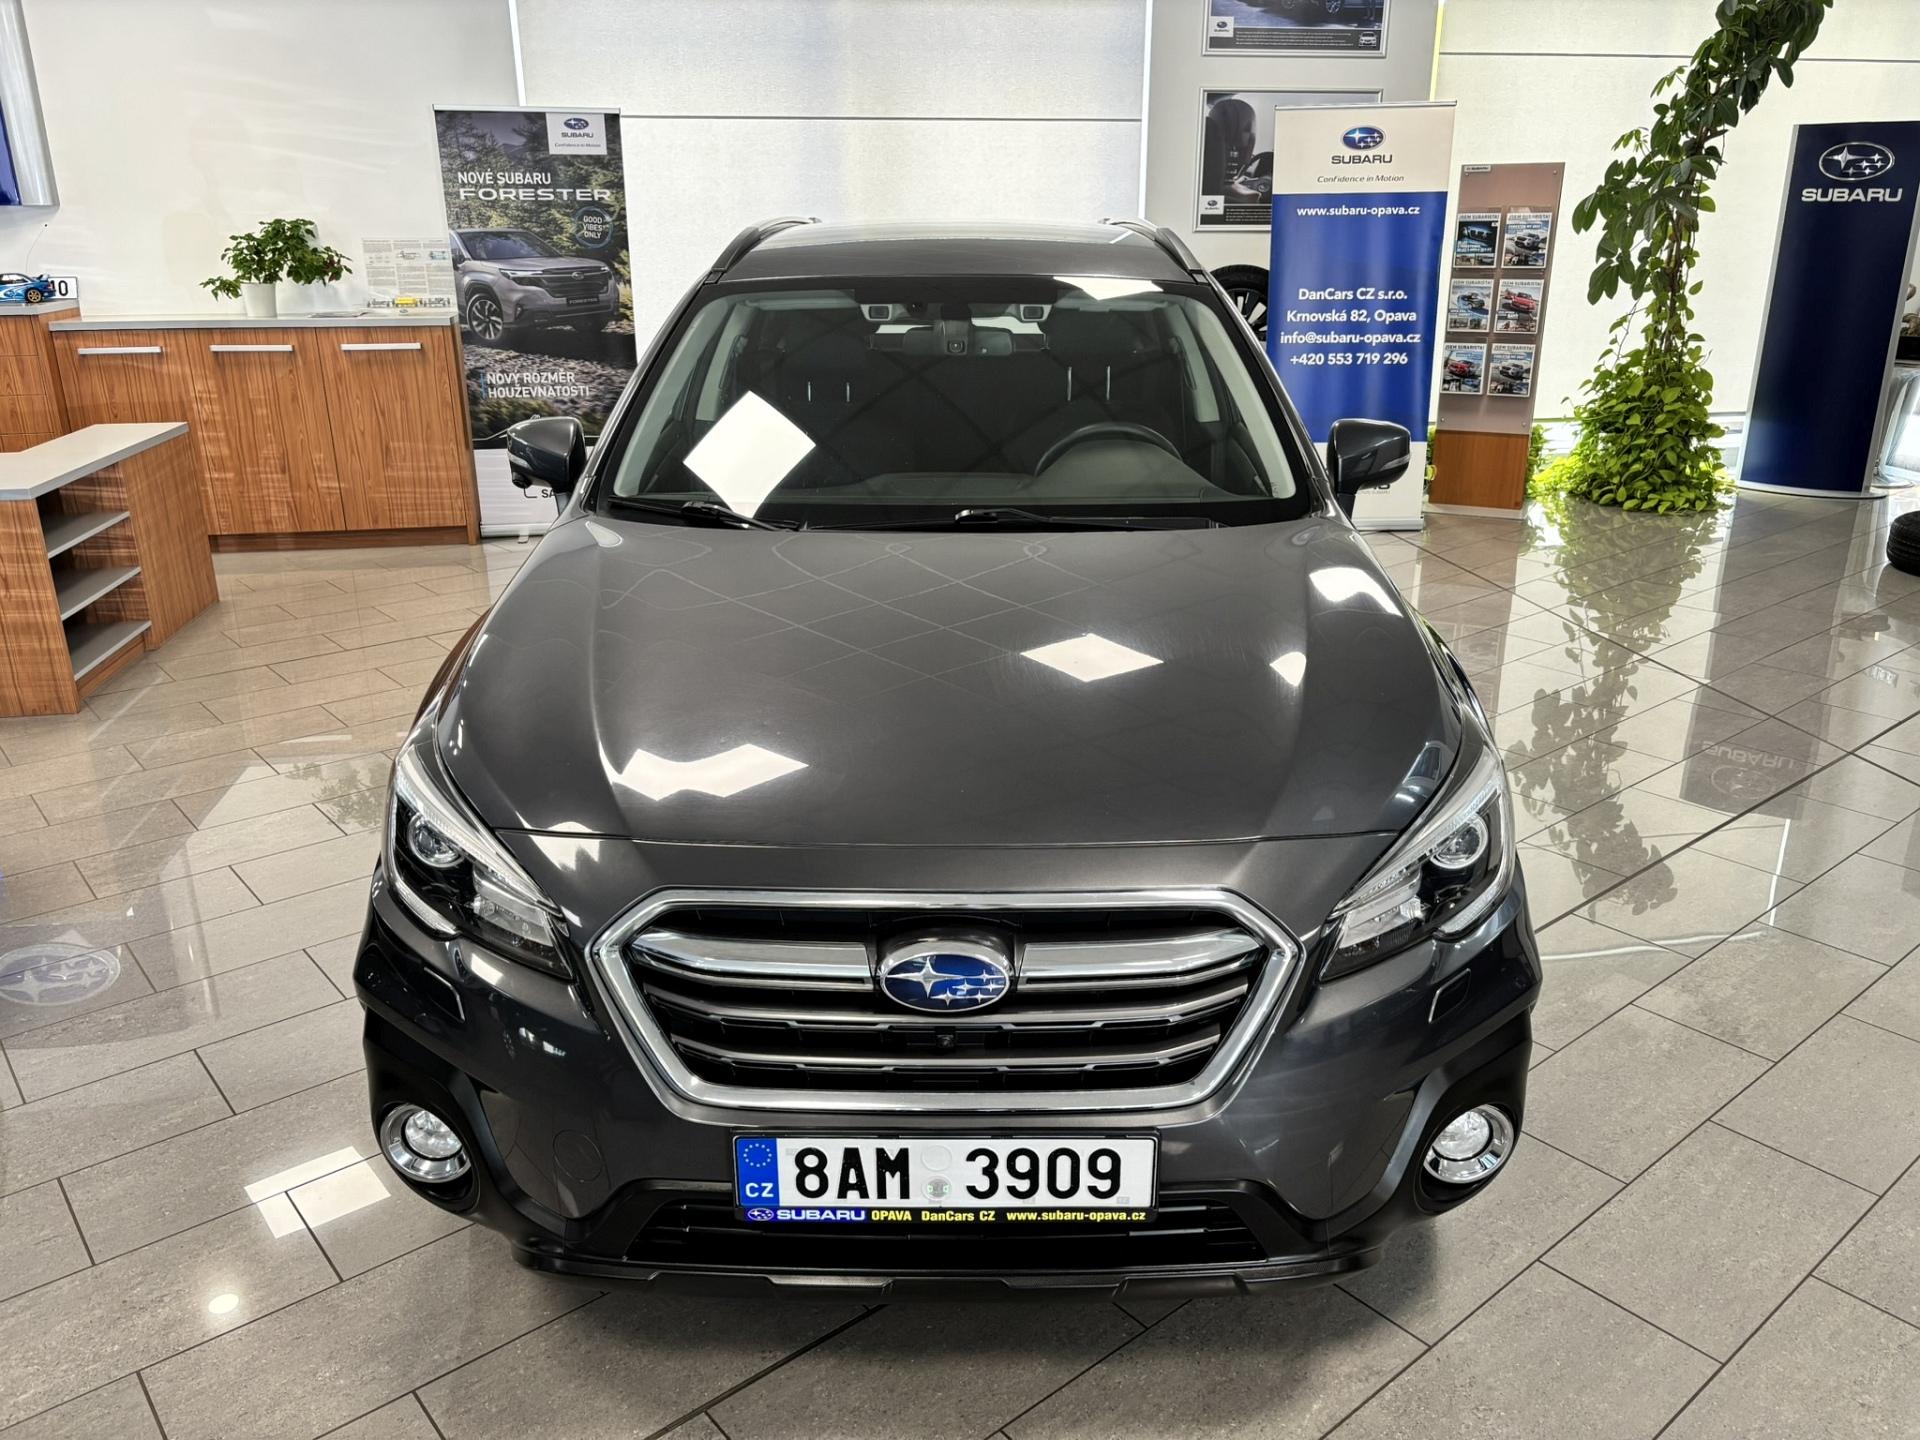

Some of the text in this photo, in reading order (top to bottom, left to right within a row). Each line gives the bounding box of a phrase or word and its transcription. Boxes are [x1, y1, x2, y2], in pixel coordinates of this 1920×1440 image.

[1331, 154, 1393, 165] SUBARU
[458, 168, 551, 185] NOVÉ SUBARU
[1317, 175, 1365, 183] Confidence
[1375, 174, 1405, 182] Motion
[459, 188, 612, 201] FORESTER
[1801, 188, 1903, 202] SUBARU
[1296, 204, 1421, 217] www.subaru-opava.cz
[1298, 288, 1408, 300] DanCars CZ s.r.o.
[1286, 309, 1417, 324] Krnovská 82, Opava
[1280, 331, 1421, 346] info@subaru-opava.cz
[1290, 352, 1408, 365] +420 553 719 296
[486, 368, 576, 385] NOVÝ ROZMĚR
[488, 382, 590, 399] HOUŽEVNATOSTI
[794, 1146, 1121, 1200] 8AM 3909
[745, 1182, 774, 1198] CZ
[776, 1208, 1146, 1222] SUBARU OPAVA DanCars CZ www.subaru-opava.cz
